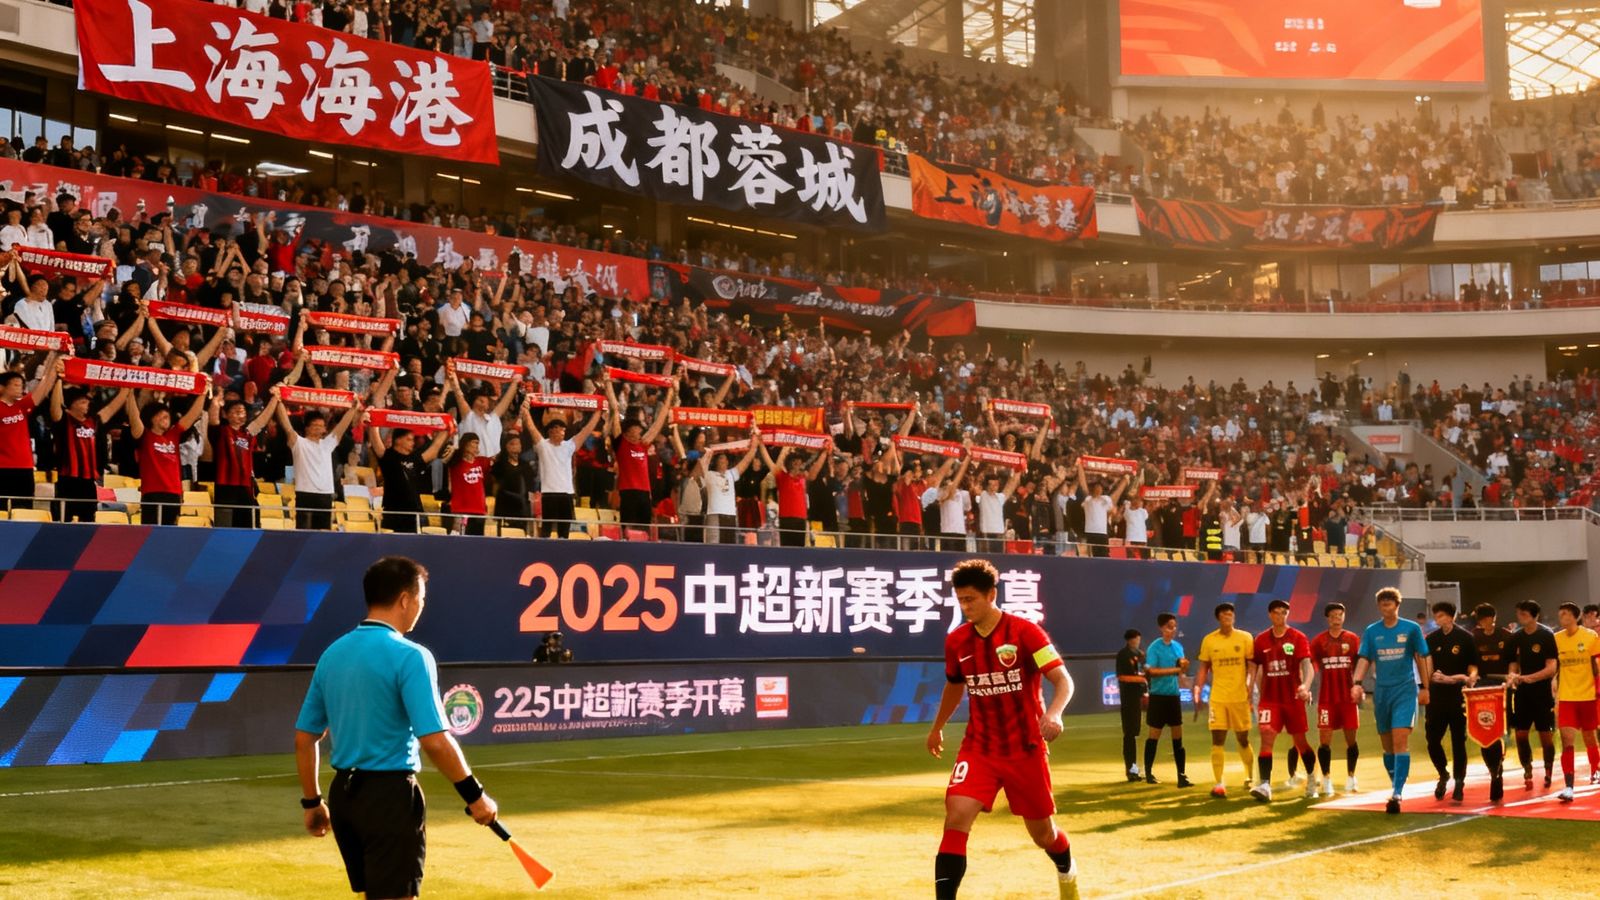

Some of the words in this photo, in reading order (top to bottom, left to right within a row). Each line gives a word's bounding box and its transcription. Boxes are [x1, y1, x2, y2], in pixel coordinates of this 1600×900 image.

[97, 0, 474, 147] 上海海港
[561, 90, 867, 223] 成都蓉城
